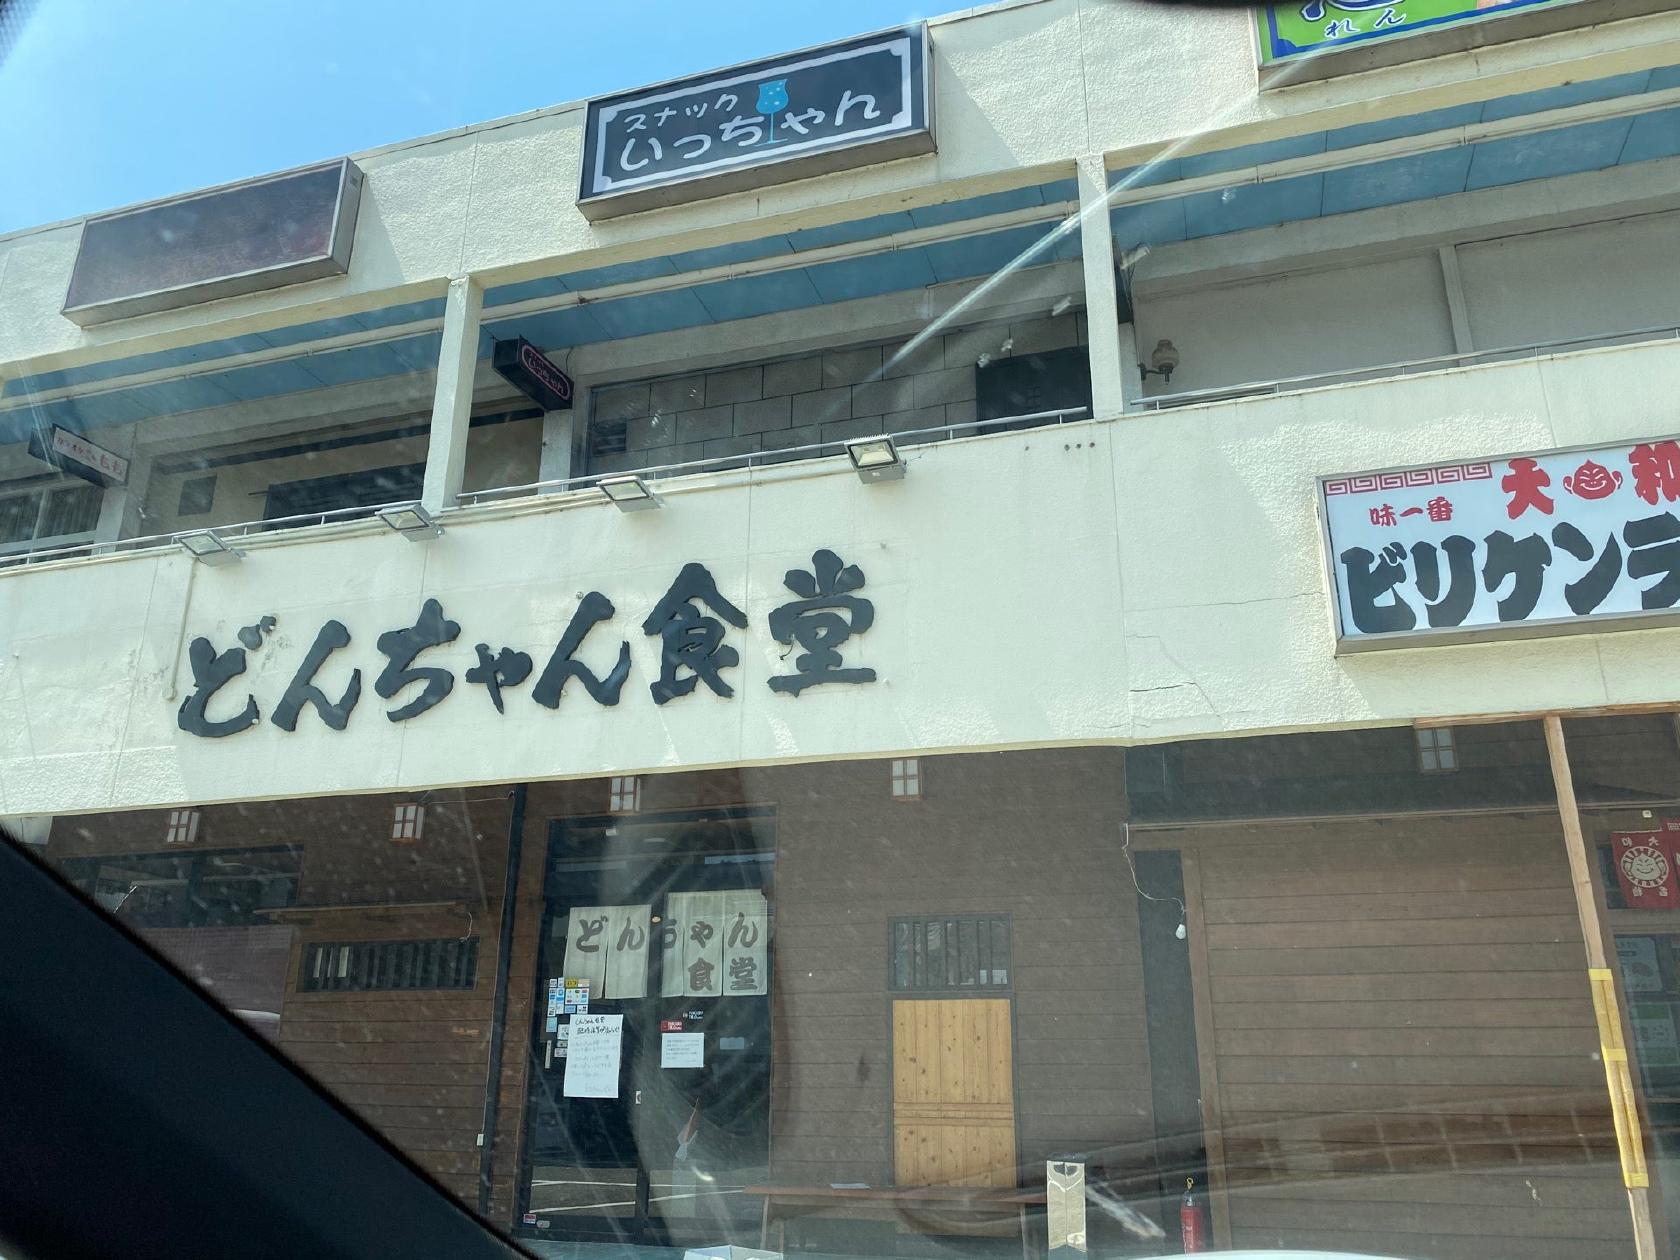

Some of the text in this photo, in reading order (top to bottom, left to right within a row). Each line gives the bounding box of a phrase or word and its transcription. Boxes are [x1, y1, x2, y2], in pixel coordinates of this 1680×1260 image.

[1324, 8, 1407, 38] れん
[619, 89, 881, 172] いっちゃん
[624, 94, 739, 133] スナック
[1368, 496, 1454, 528] 味一番
[1501, 458, 1555, 520] 大
[177, 549, 877, 738] どんちゃん食堂
